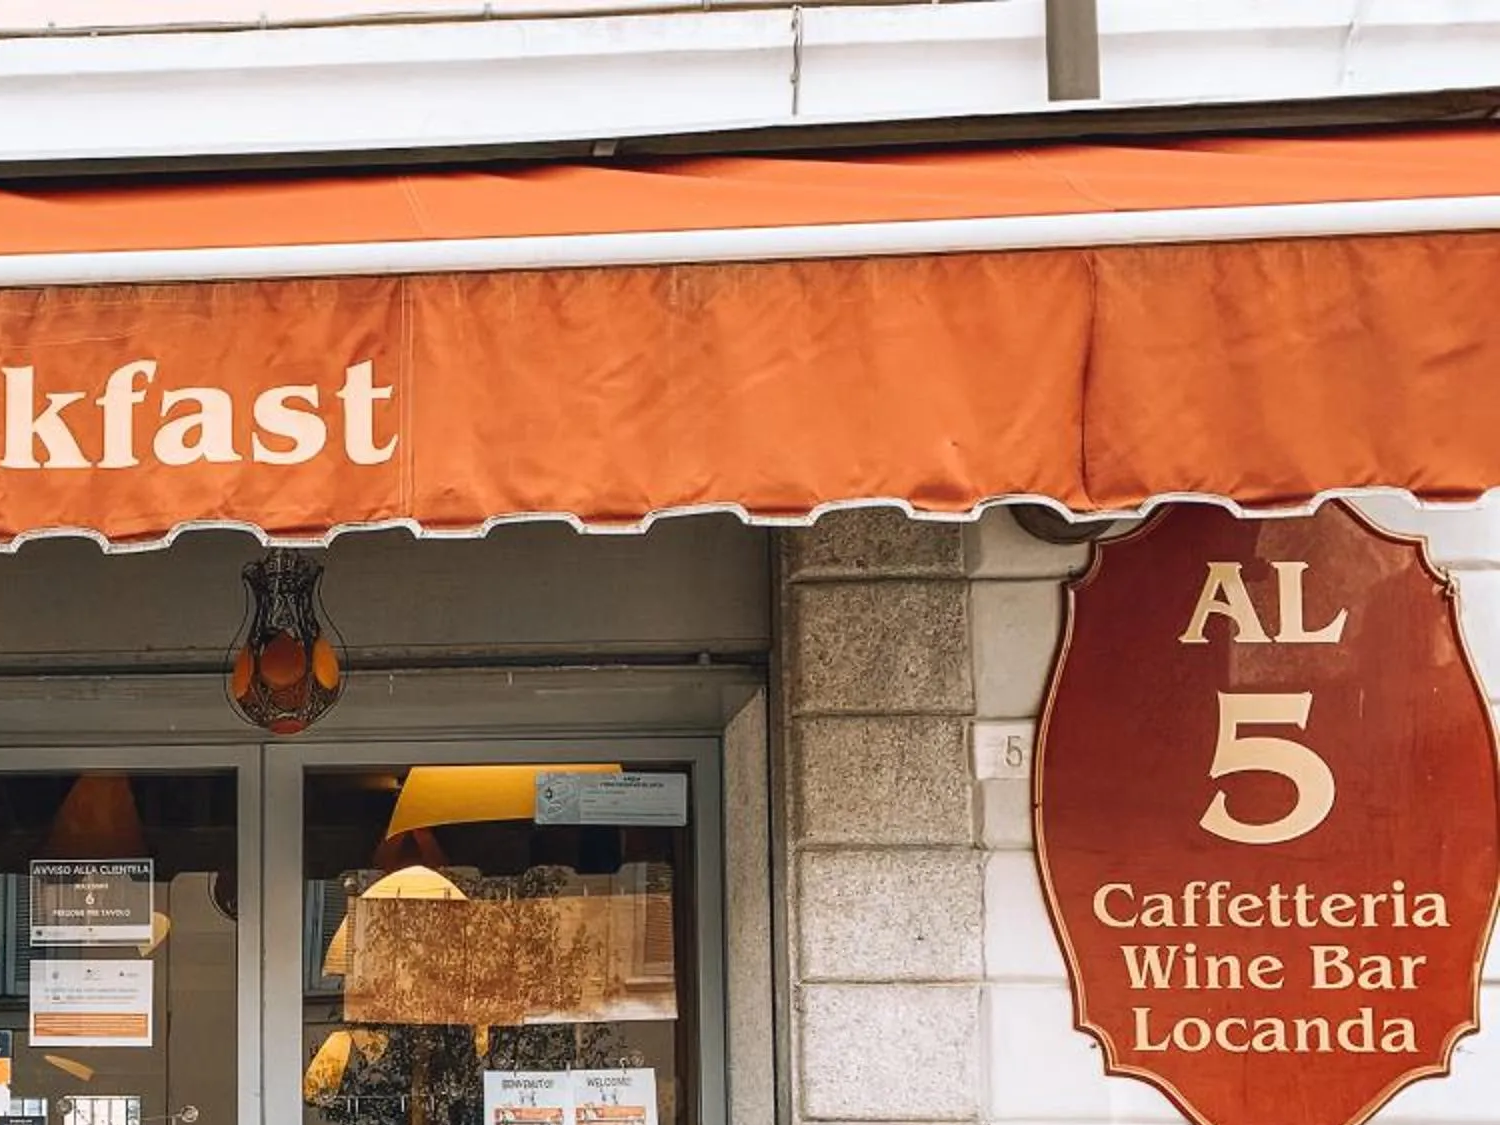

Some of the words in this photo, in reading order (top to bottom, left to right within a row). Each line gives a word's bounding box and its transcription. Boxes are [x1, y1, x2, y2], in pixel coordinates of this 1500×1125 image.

[1178, 561, 1348, 644] AL
[1005, 735, 1023, 767] 5
[1199, 691, 1336, 845] 5
[73, 865, 98, 875] ALLA
[100, 865, 150, 875] CLIENTELA
[85, 892, 95, 905] 6
[1092, 880, 1450, 928] Caffetteria
[1121, 943, 1285, 990] Wine
[1309, 945, 1426, 990] Bar
[1132, 1007, 1418, 1053] Locanda
